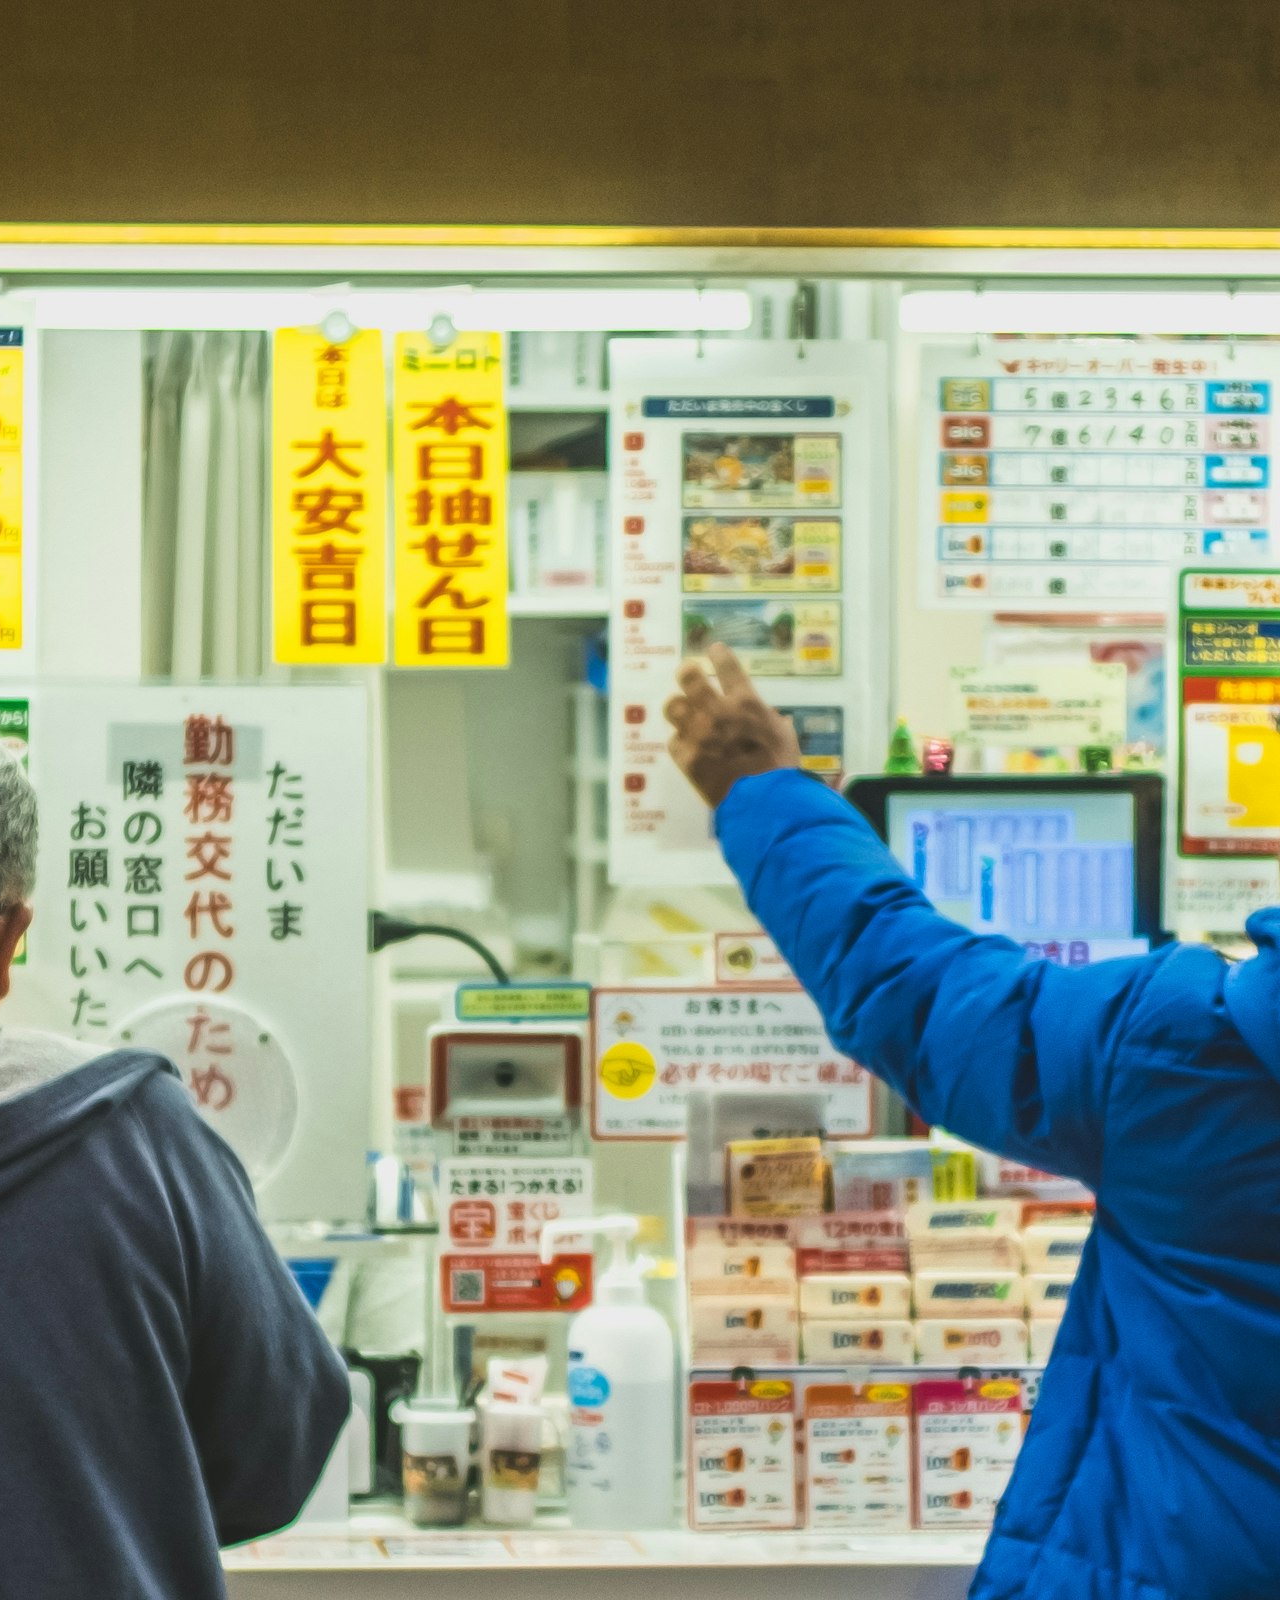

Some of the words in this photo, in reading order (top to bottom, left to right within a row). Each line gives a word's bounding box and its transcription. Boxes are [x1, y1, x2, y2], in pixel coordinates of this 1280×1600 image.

[290, 428, 365, 647] 大安吉日
[407, 396, 495, 655] 本日抽せん日
[68, 800, 111, 1032] お願いいた
[122, 759, 164, 981] 隣の窓口へ
[182, 713, 235, 1112] 勤務交代のため
[265, 759, 305, 941] ただいま
